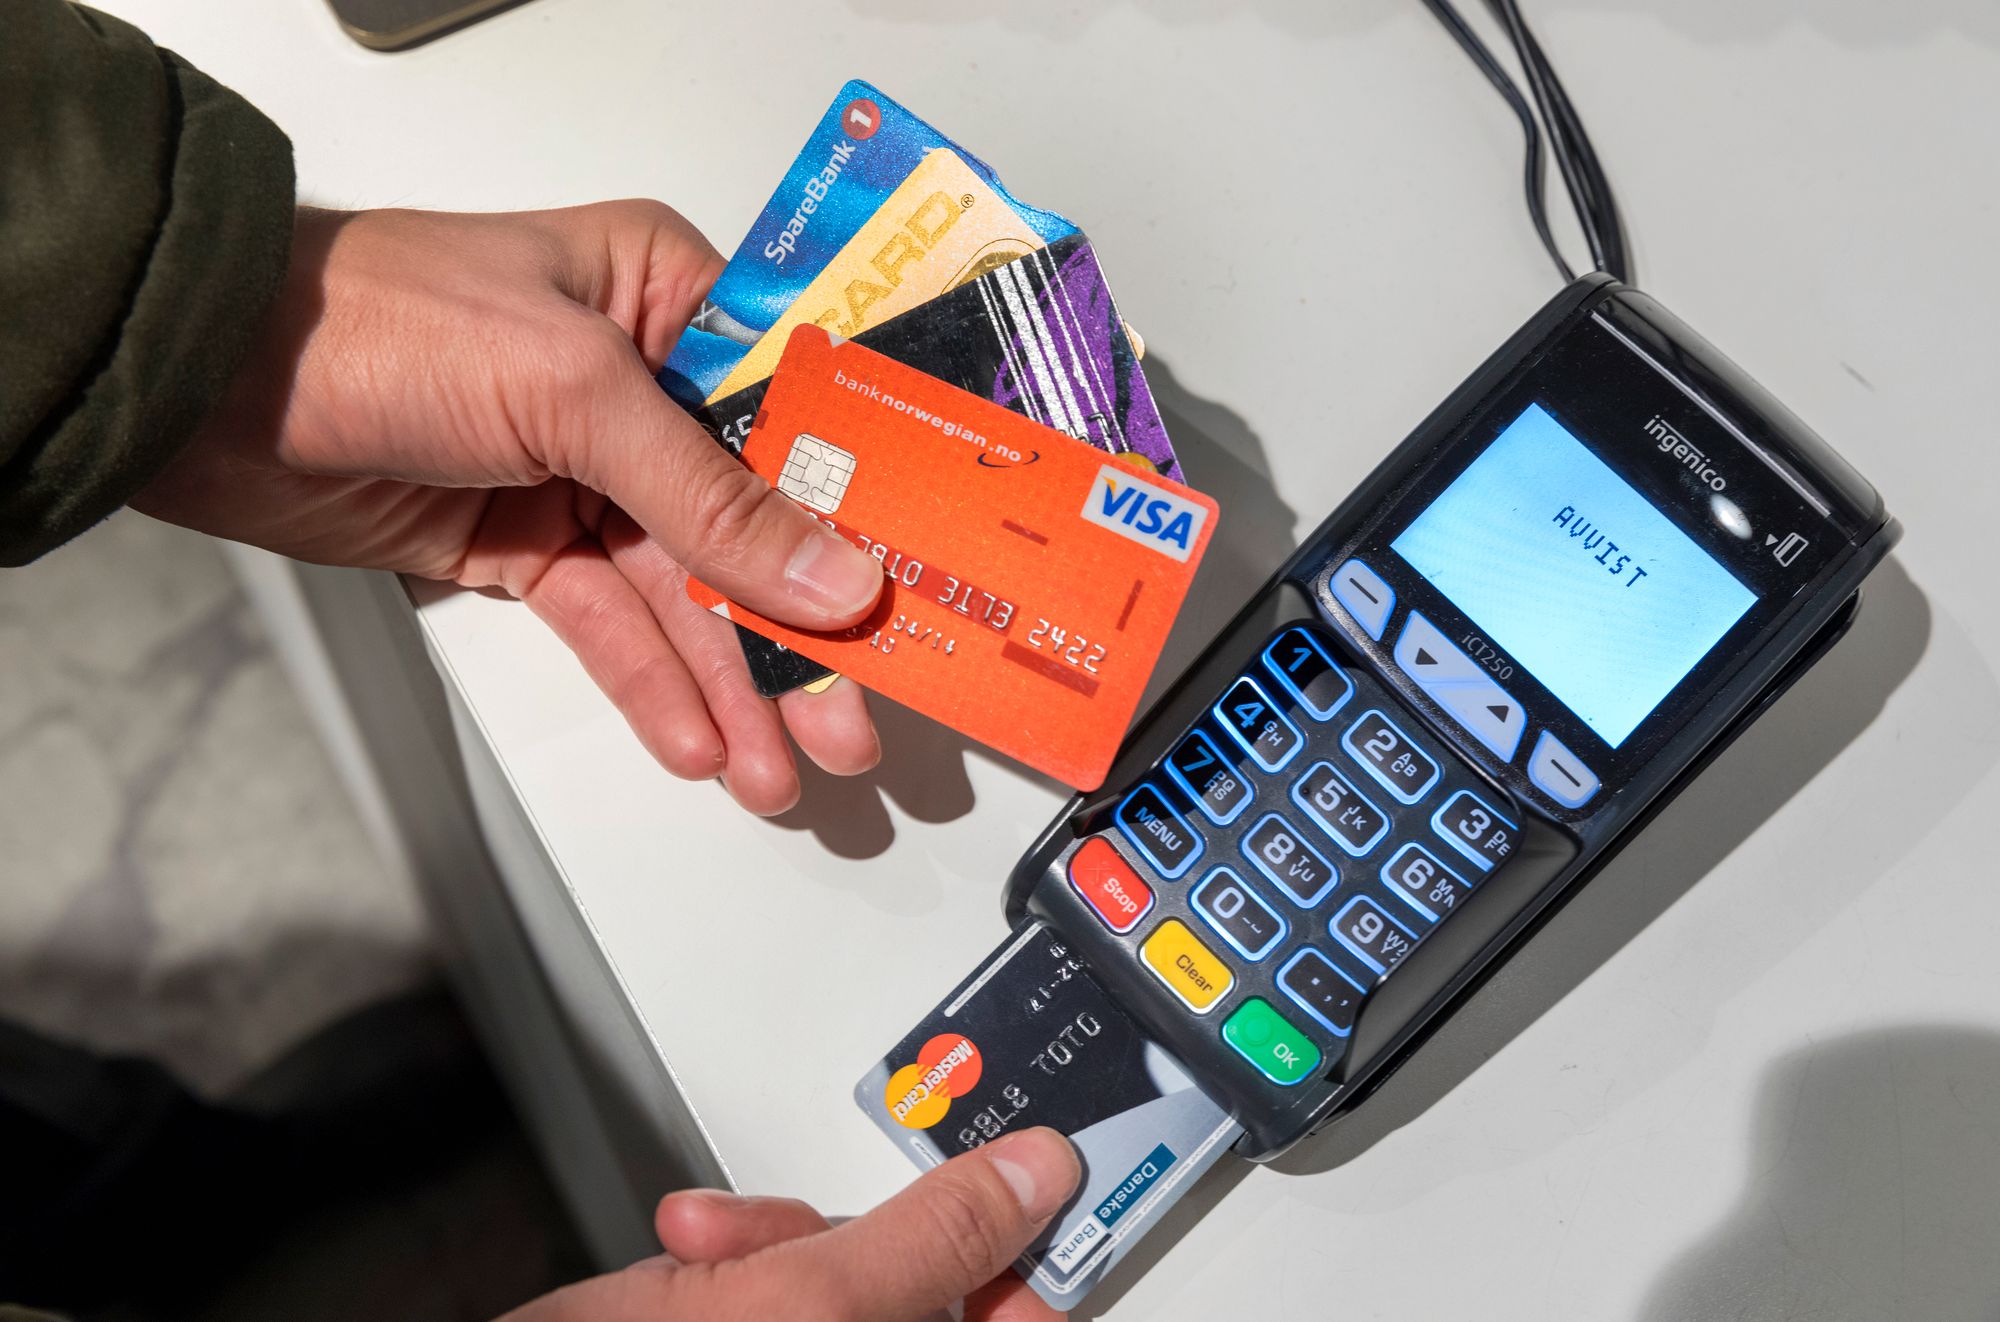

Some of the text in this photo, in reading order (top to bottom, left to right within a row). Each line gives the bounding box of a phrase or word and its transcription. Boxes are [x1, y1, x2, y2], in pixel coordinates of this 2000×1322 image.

[764, 109, 872, 265] SpareBank 1
[1643, 415, 1726, 491] ingenico
[1102, 476, 1194, 550] VISA
[1552, 505, 1648, 589] AVVIST
[938, 577, 1014, 630] 3173
[1027, 618, 1106, 673] 2422
[1288, 647, 1312, 672] 1
[1461, 631, 1513, 680] iCT250
[1234, 702, 1265, 728] 4
[1182, 745, 1216, 772] 7
[1363, 729, 1398, 762] 2
[1314, 779, 1348, 811] 5
[1135, 806, 1182, 851] MENU
[1459, 808, 1491, 840] 3
[1263, 833, 1295, 865] 8
[1402, 858, 1435, 890] 6
[1103, 877, 1138, 915] Stop
[1212, 887, 1245, 919] 0
[1352, 912, 1384, 944] 9
[1175, 954, 1213, 994] Clear
[1273, 1043, 1300, 1070] OK
[893, 1039, 974, 1122] MasterCard
[1099, 1161, 1157, 1221] Danske
[1057, 1222, 1097, 1262] Bank
